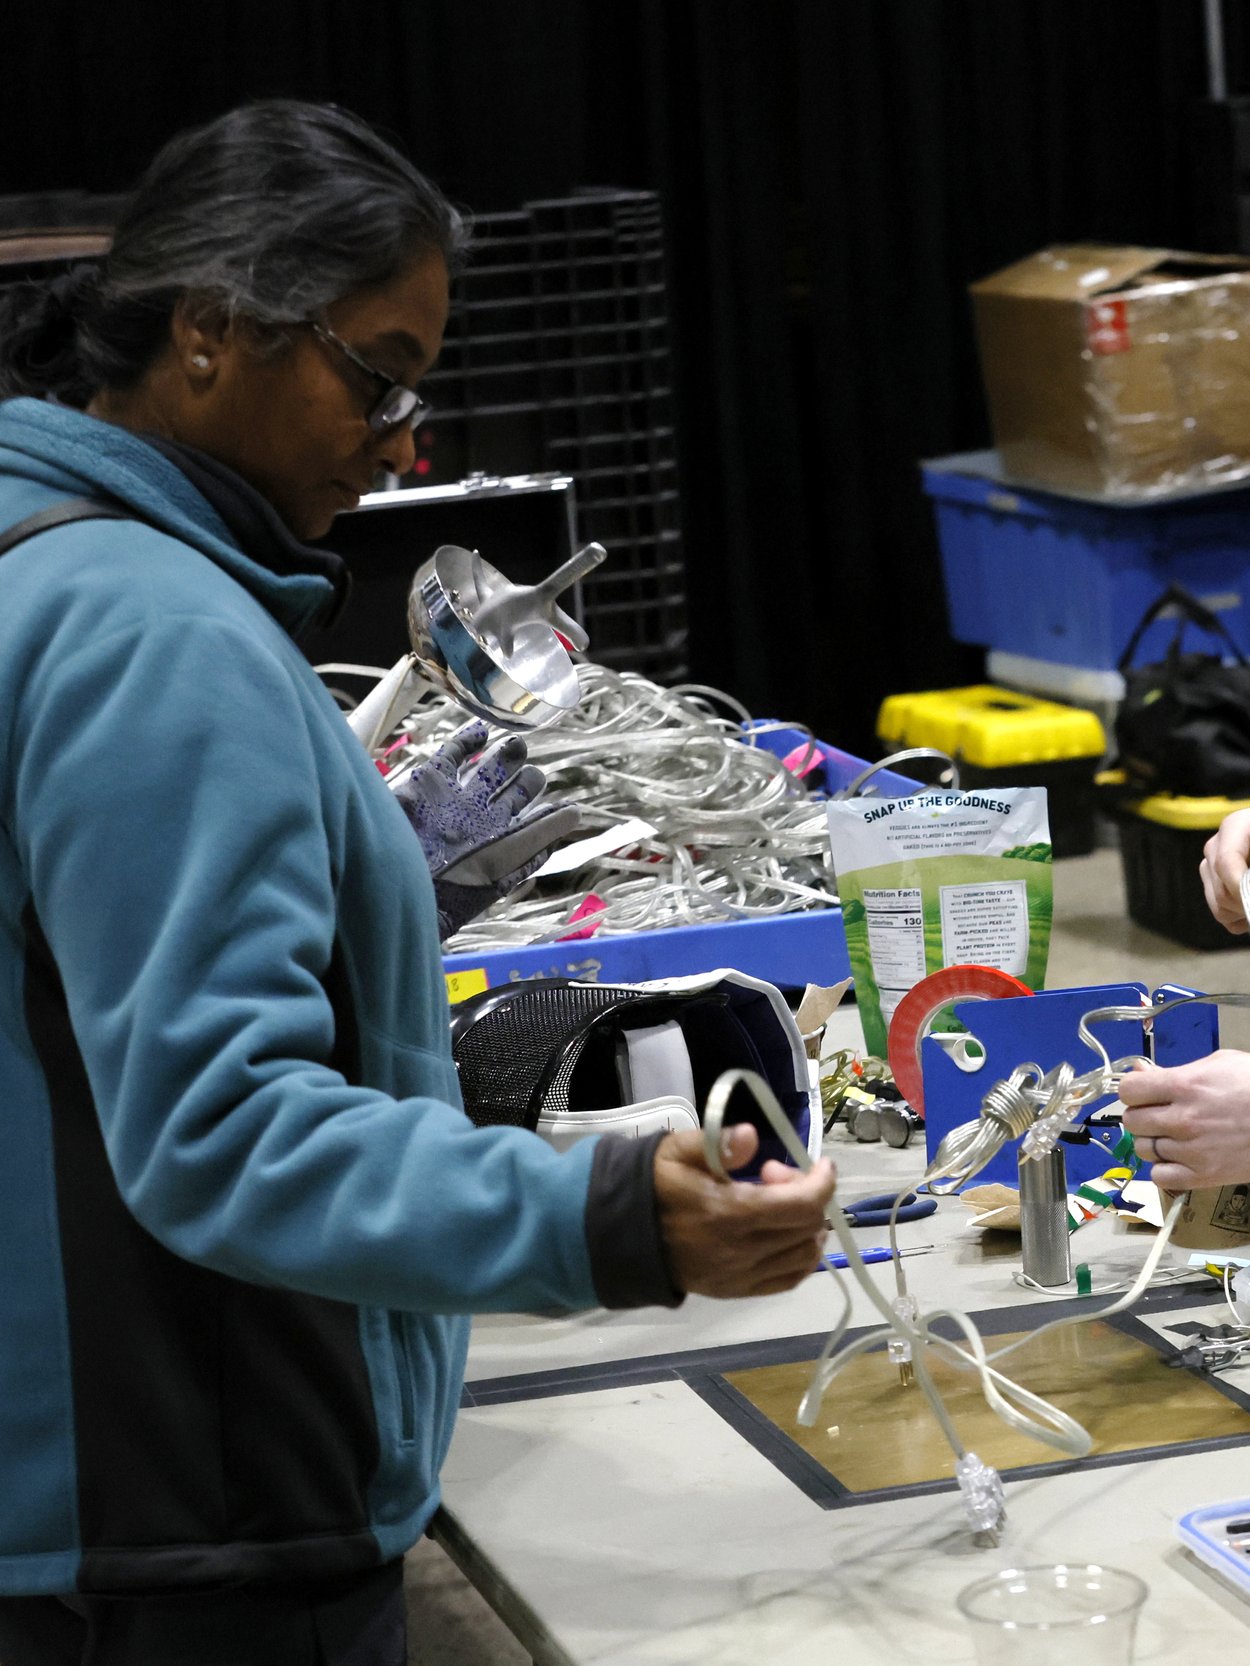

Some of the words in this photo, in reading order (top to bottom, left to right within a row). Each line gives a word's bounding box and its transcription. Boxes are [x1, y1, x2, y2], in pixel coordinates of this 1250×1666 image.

[864, 803, 896, 824] SNAP
[918, 796, 942, 808] THE
[945, 796, 1012, 815] GOODNESS
[864, 890, 896, 898] Nutrition
[898, 890, 920, 898] Facts
[903, 917, 922, 926] 130
